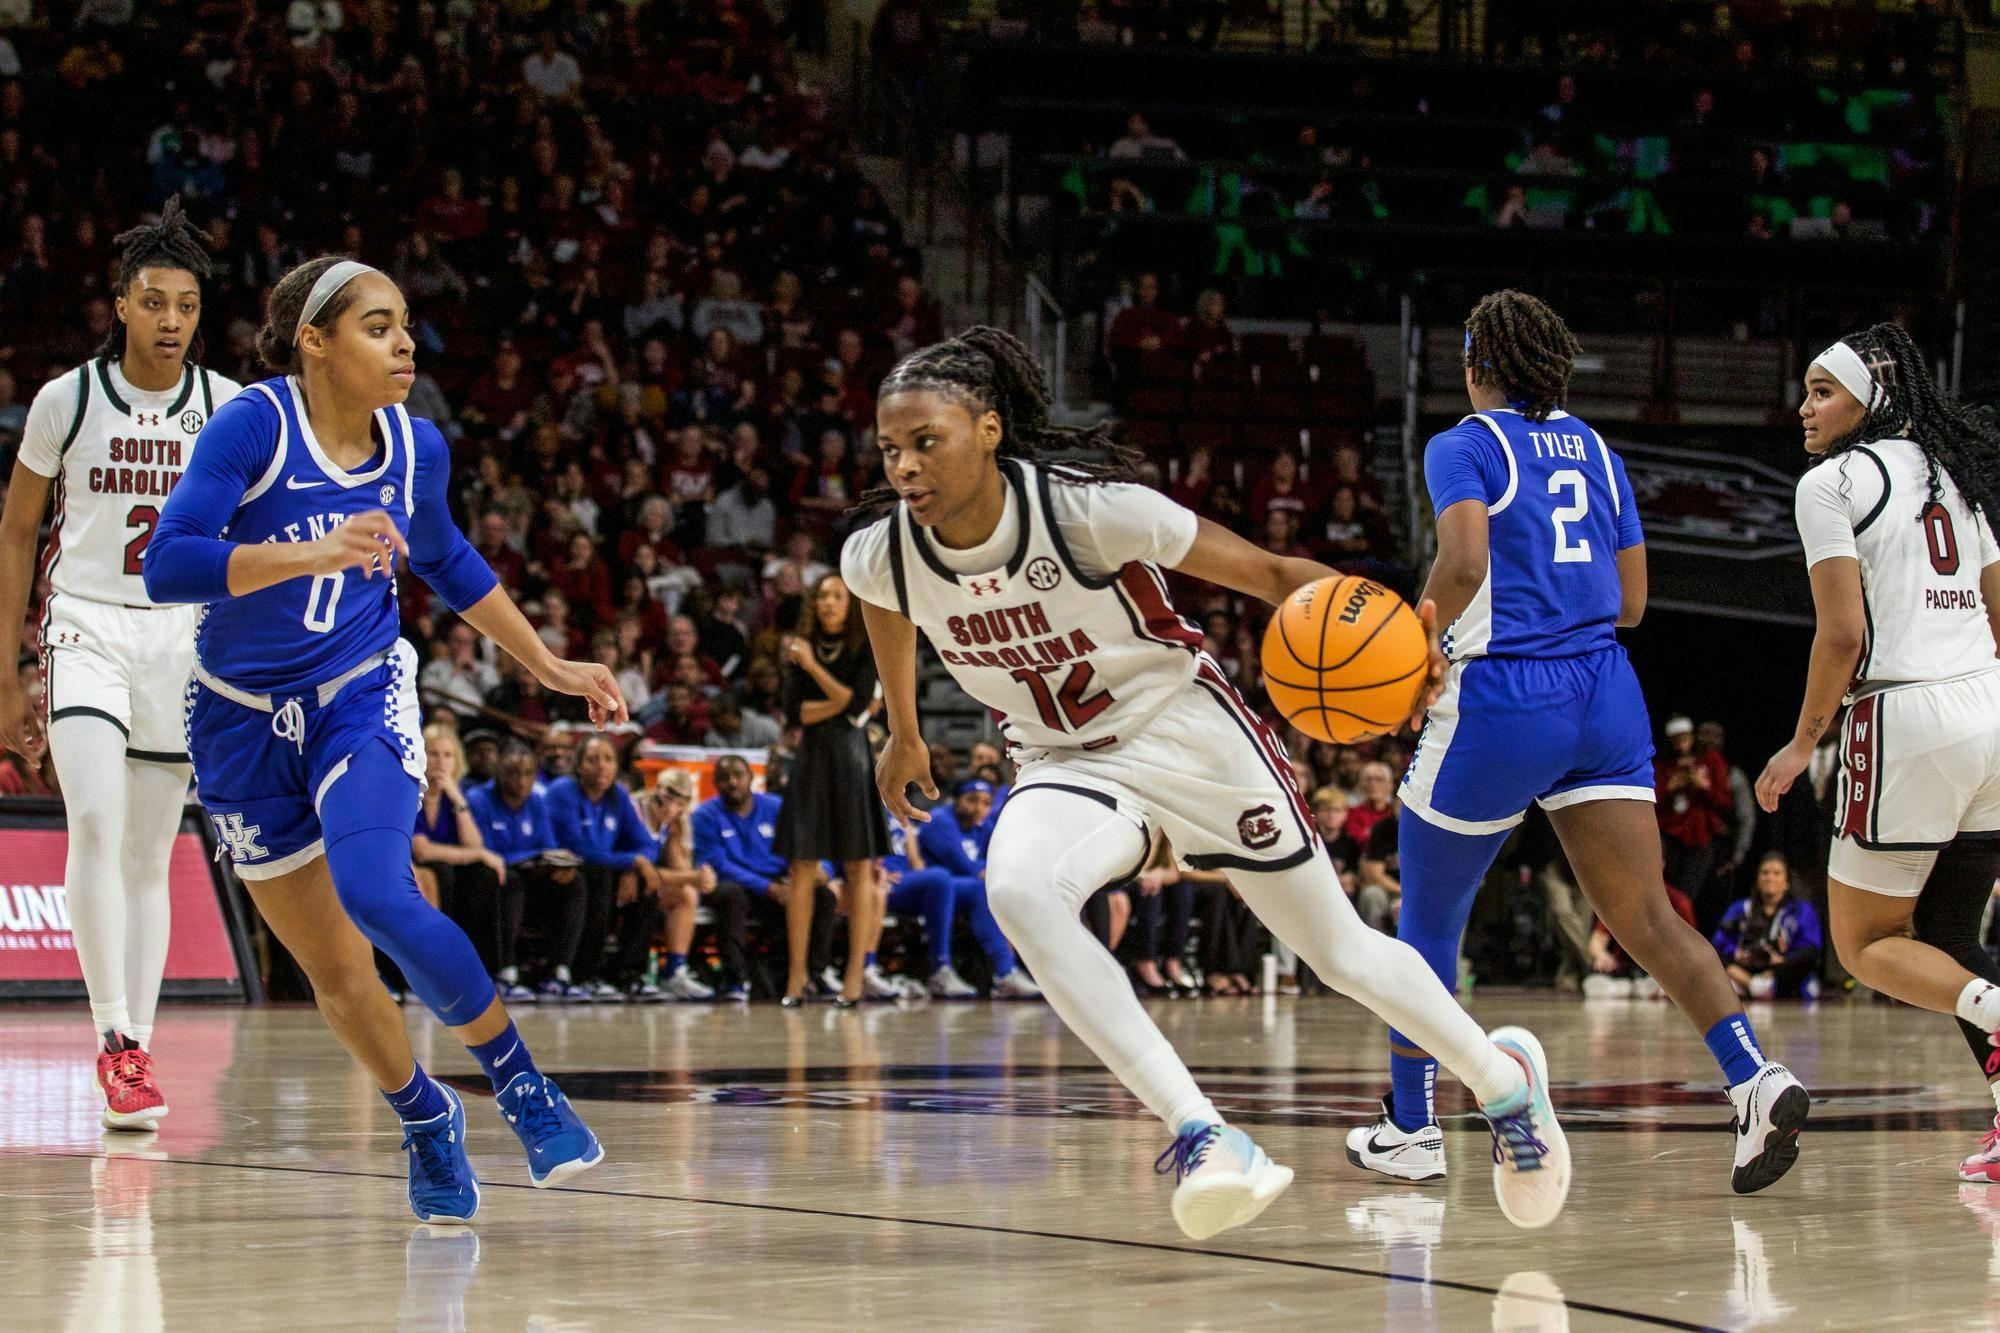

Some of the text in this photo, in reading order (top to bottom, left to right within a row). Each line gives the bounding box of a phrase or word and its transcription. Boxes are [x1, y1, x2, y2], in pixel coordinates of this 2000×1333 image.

[109, 437, 181, 466] SOUTH
[1528, 432, 1587, 461] TYLER
[89, 467, 183, 496] CAROLIN
[1548, 469, 1592, 563] 2
[123, 504, 160, 575] 2
[1921, 502, 1960, 576] 0
[1025, 556, 1062, 591] SEC
[303, 571, 345, 633] 0
[1925, 588, 1977, 610] PAOPAO
[946, 601, 1053, 647] SOUTH
[941, 628, 1099, 670] CAROLINA
[1009, 660, 1117, 735] 12
